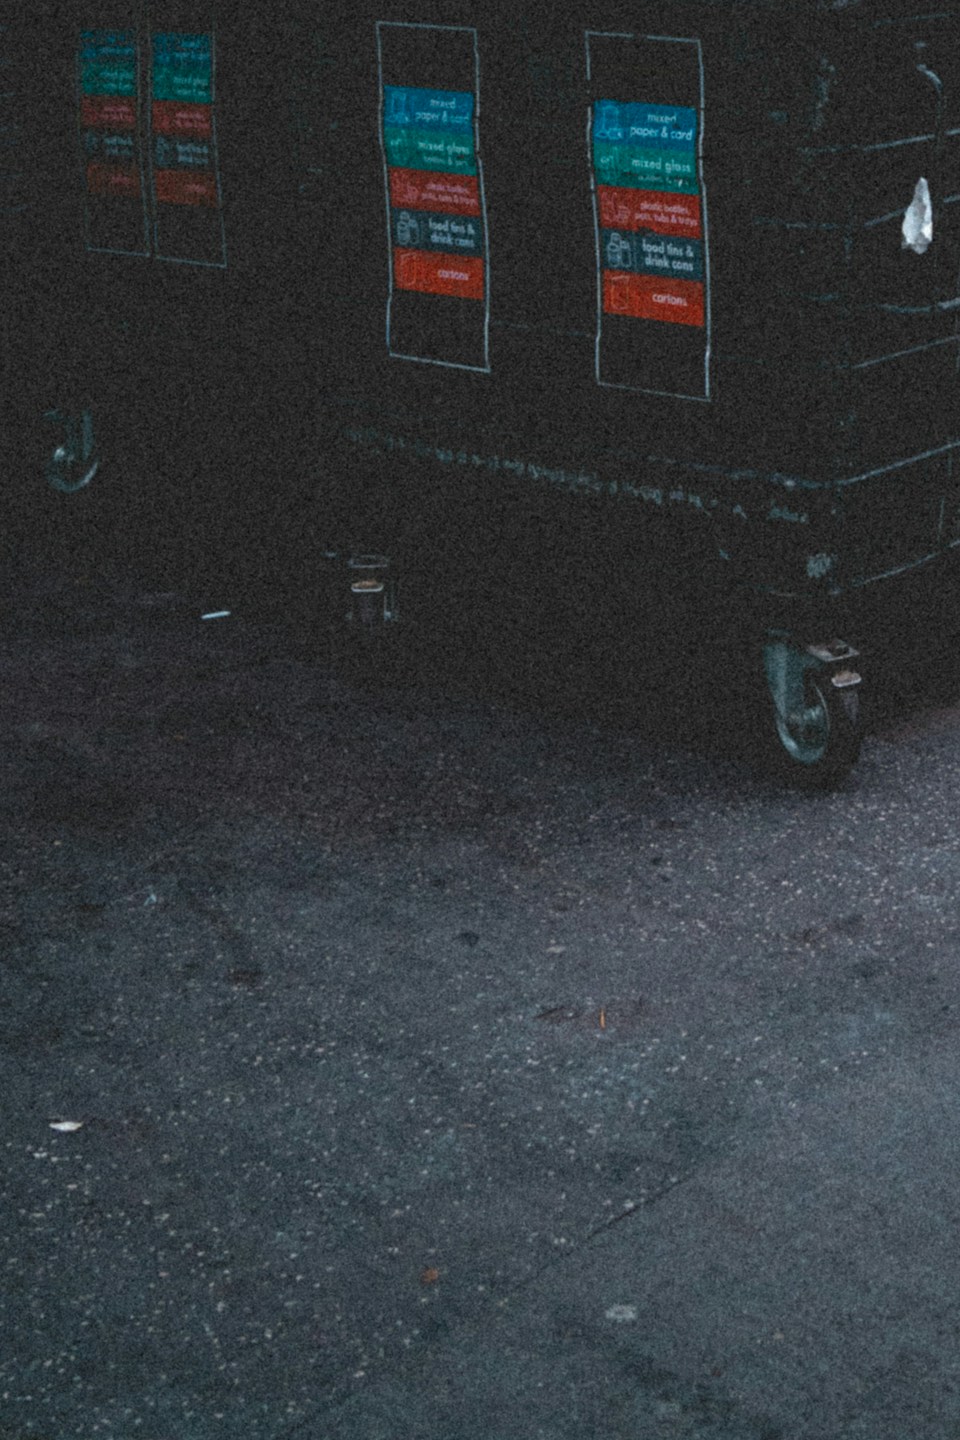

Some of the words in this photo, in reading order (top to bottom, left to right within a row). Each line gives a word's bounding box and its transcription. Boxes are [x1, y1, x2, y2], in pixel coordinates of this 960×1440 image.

[630, 125, 658, 138] paper
[660, 125, 668, 138] &
[670, 128, 693, 140] card
[631, 156, 662, 169] mixed
[664, 158, 691, 174] glass
[642, 238, 665, 254] food
[666, 243, 684, 257] tins
[685, 245, 694, 258] &
[645, 255, 670, 268] drink
[672, 261, 694, 272] cans
[652, 293, 688, 307] cartons
